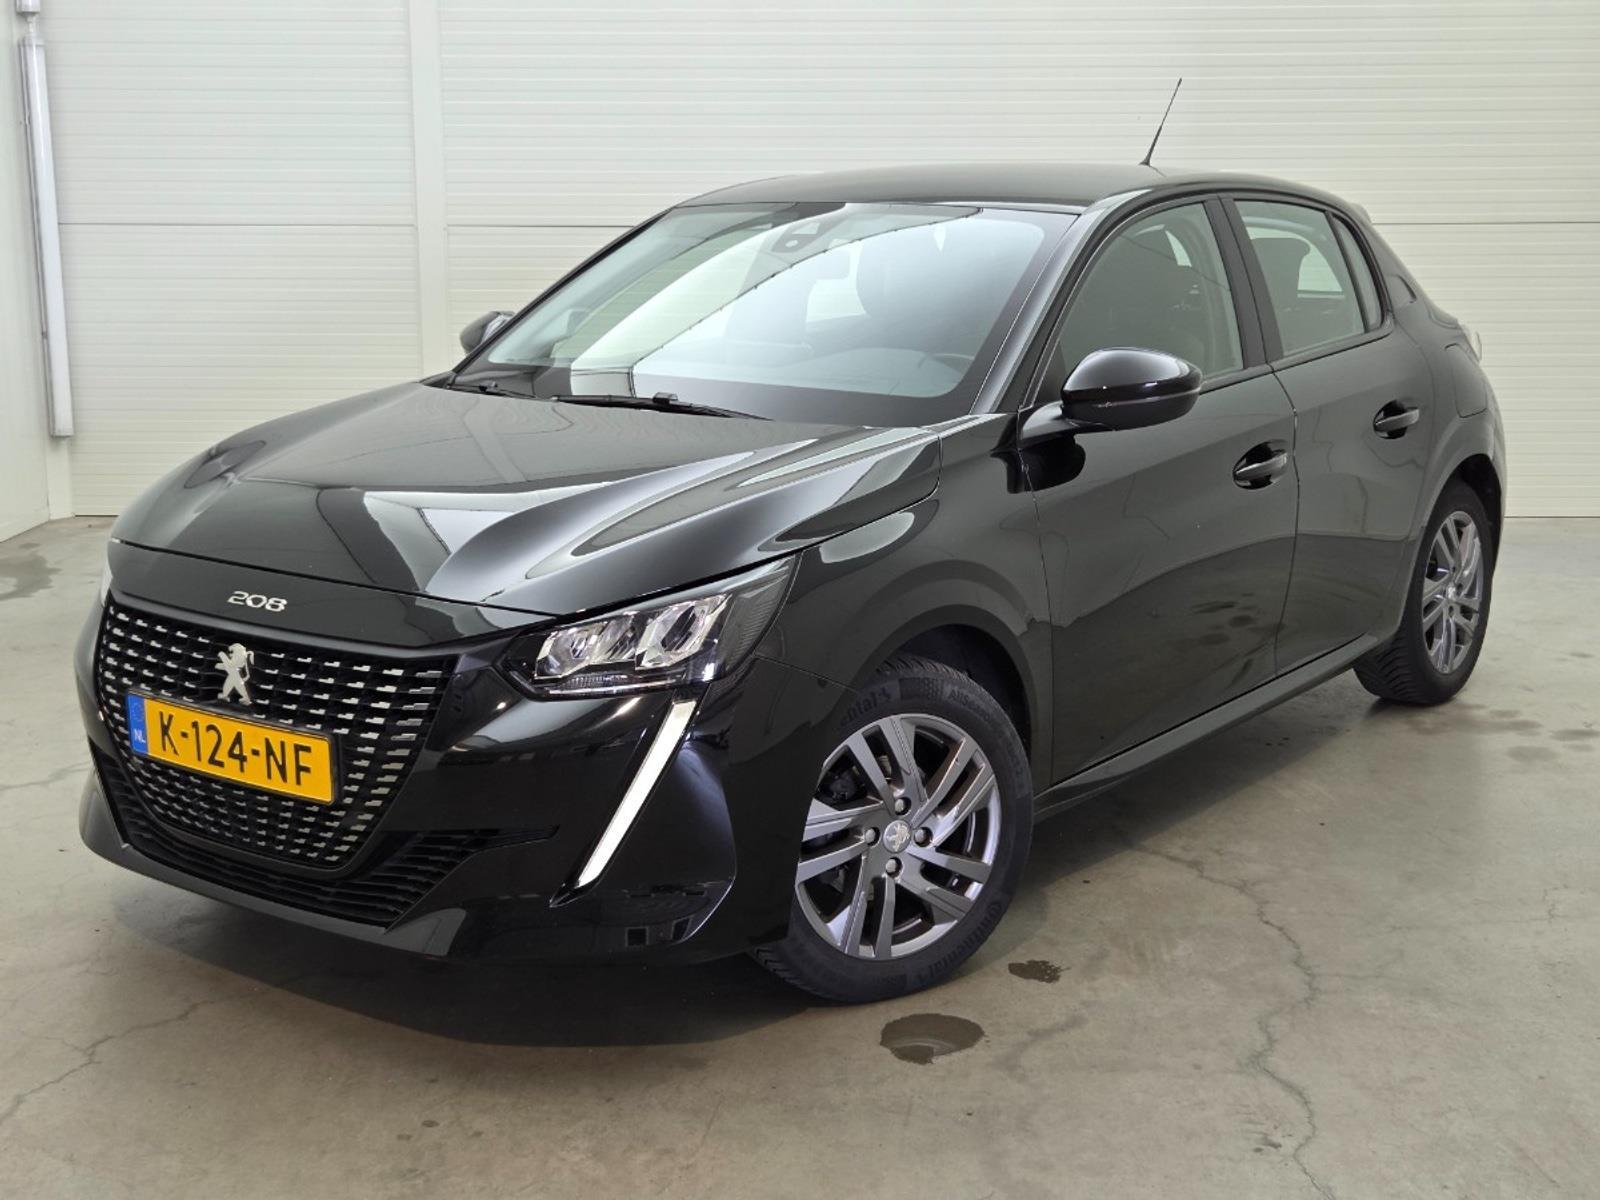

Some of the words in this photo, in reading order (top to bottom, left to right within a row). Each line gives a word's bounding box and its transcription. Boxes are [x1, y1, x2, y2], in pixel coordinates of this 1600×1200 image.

[227, 590, 288, 612] 208
[134, 729, 146, 743] NL
[159, 711, 312, 786] K-124-NF
